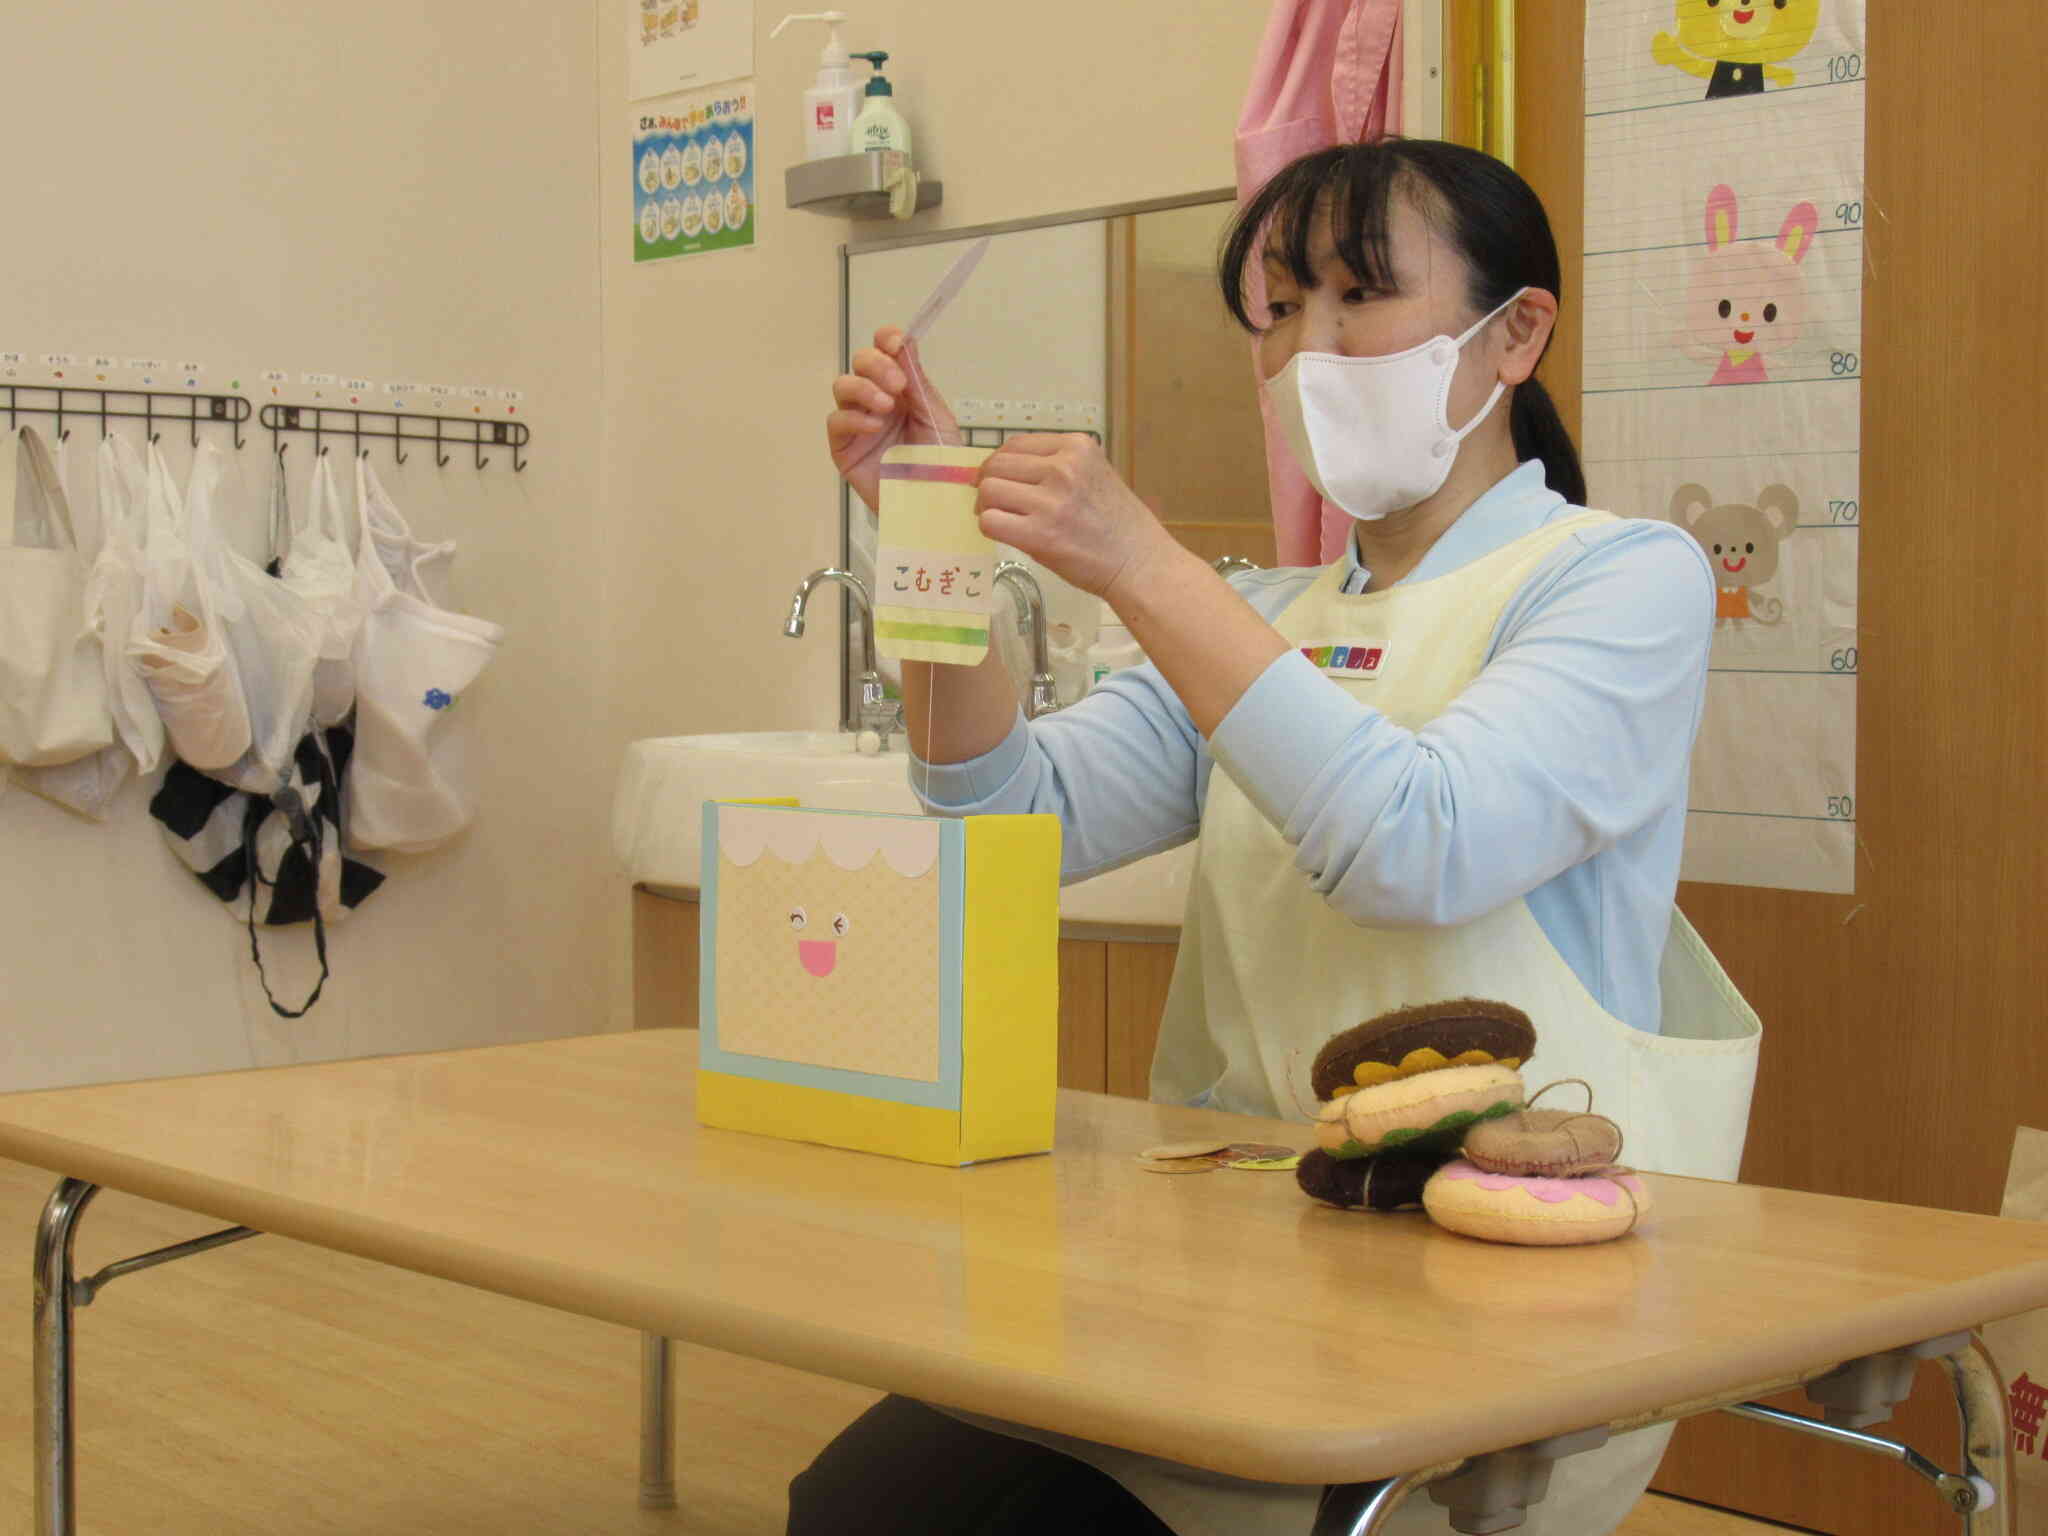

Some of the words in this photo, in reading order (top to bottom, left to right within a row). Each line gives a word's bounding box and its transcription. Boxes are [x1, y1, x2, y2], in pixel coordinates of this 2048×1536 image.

[1827, 54, 1861, 82] 100
[1835, 202, 1861, 225] 90
[1830, 352, 1858, 376] 80
[1828, 500, 1859, 523] 70
[893, 566, 982, 598] こむぎこ
[1830, 648, 1858, 671] 60
[1827, 796, 1852, 817] 50
[2008, 1371, 2048, 1461] 無
